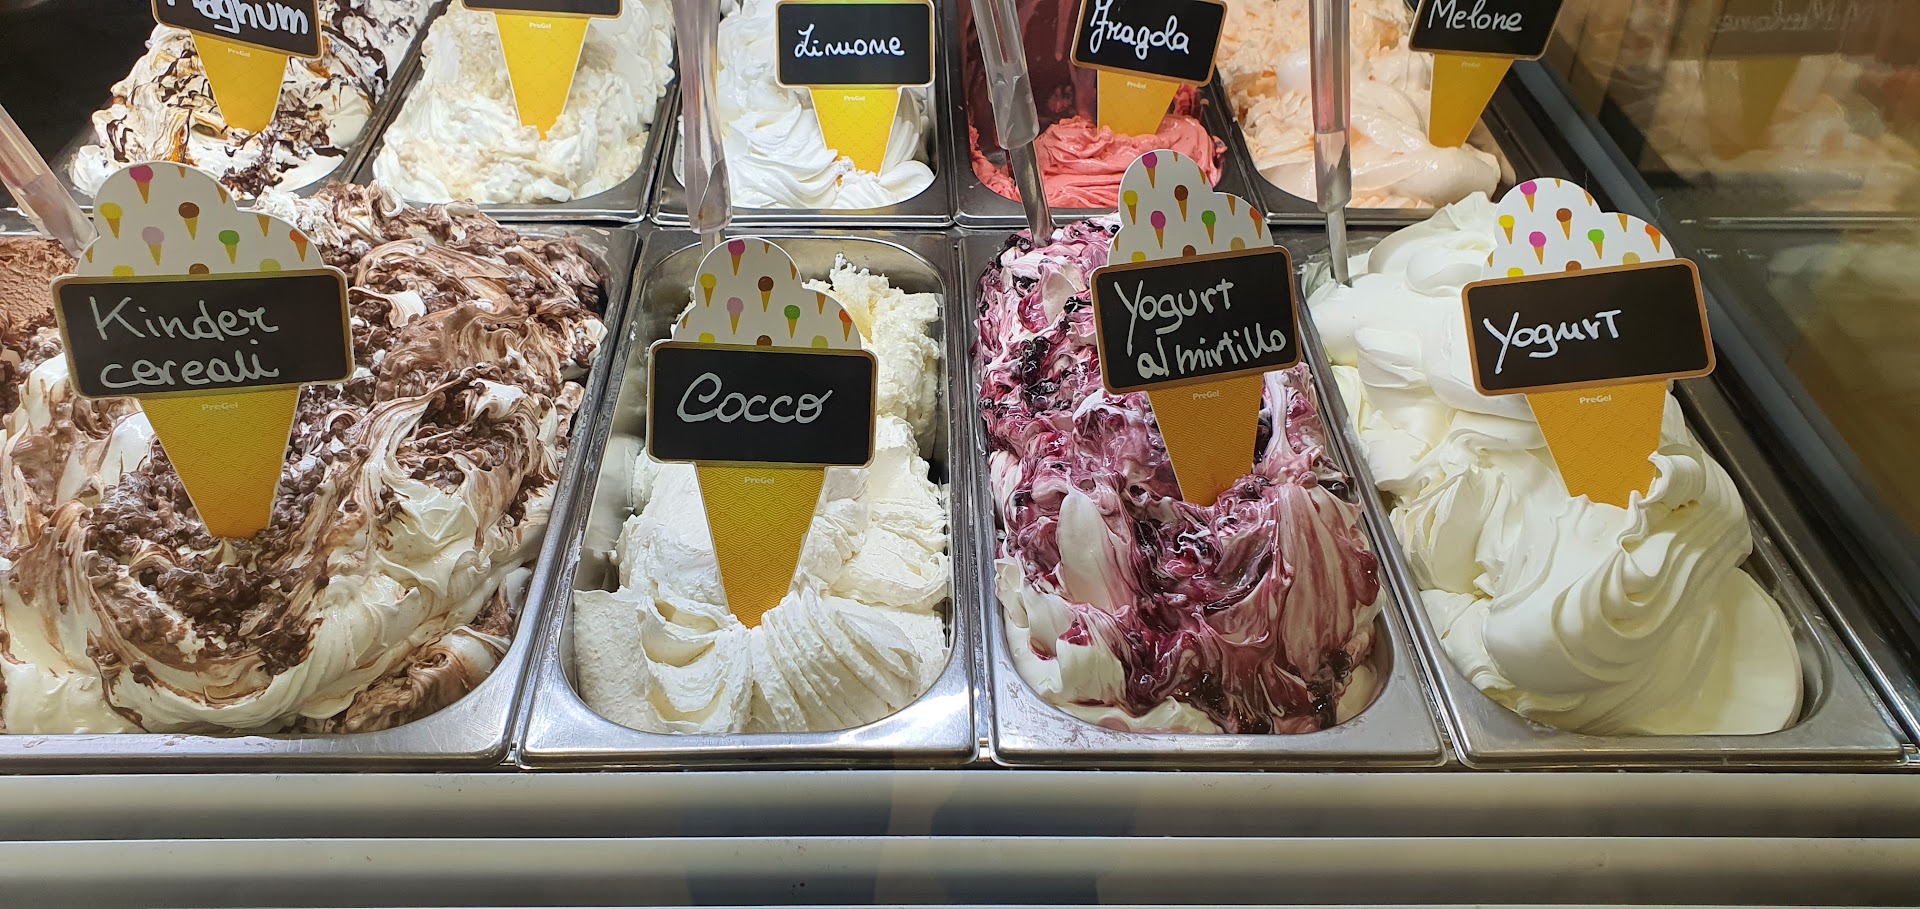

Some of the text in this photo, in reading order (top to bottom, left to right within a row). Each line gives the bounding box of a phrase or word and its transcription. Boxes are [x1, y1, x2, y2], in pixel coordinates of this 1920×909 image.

[167, 0, 309, 35] agnum
[529, 21, 552, 29] PreGel
[1090, 0, 1189, 60] Fragola
[1428, 0, 1522, 32] Melone
[794, 23, 905, 58] Limone
[89, 296, 279, 341] Kinder
[1113, 278, 1234, 357] Yogurt
[100, 338, 279, 388] cereali
[1137, 322, 1287, 379] al mirtillo
[202, 402, 238, 411] PreGel
[676, 372, 834, 424] Cocco
[1192, 390, 1220, 400] PreGel
[1579, 395, 1612, 405] PreGel
[744, 476, 775, 485] PreGel
